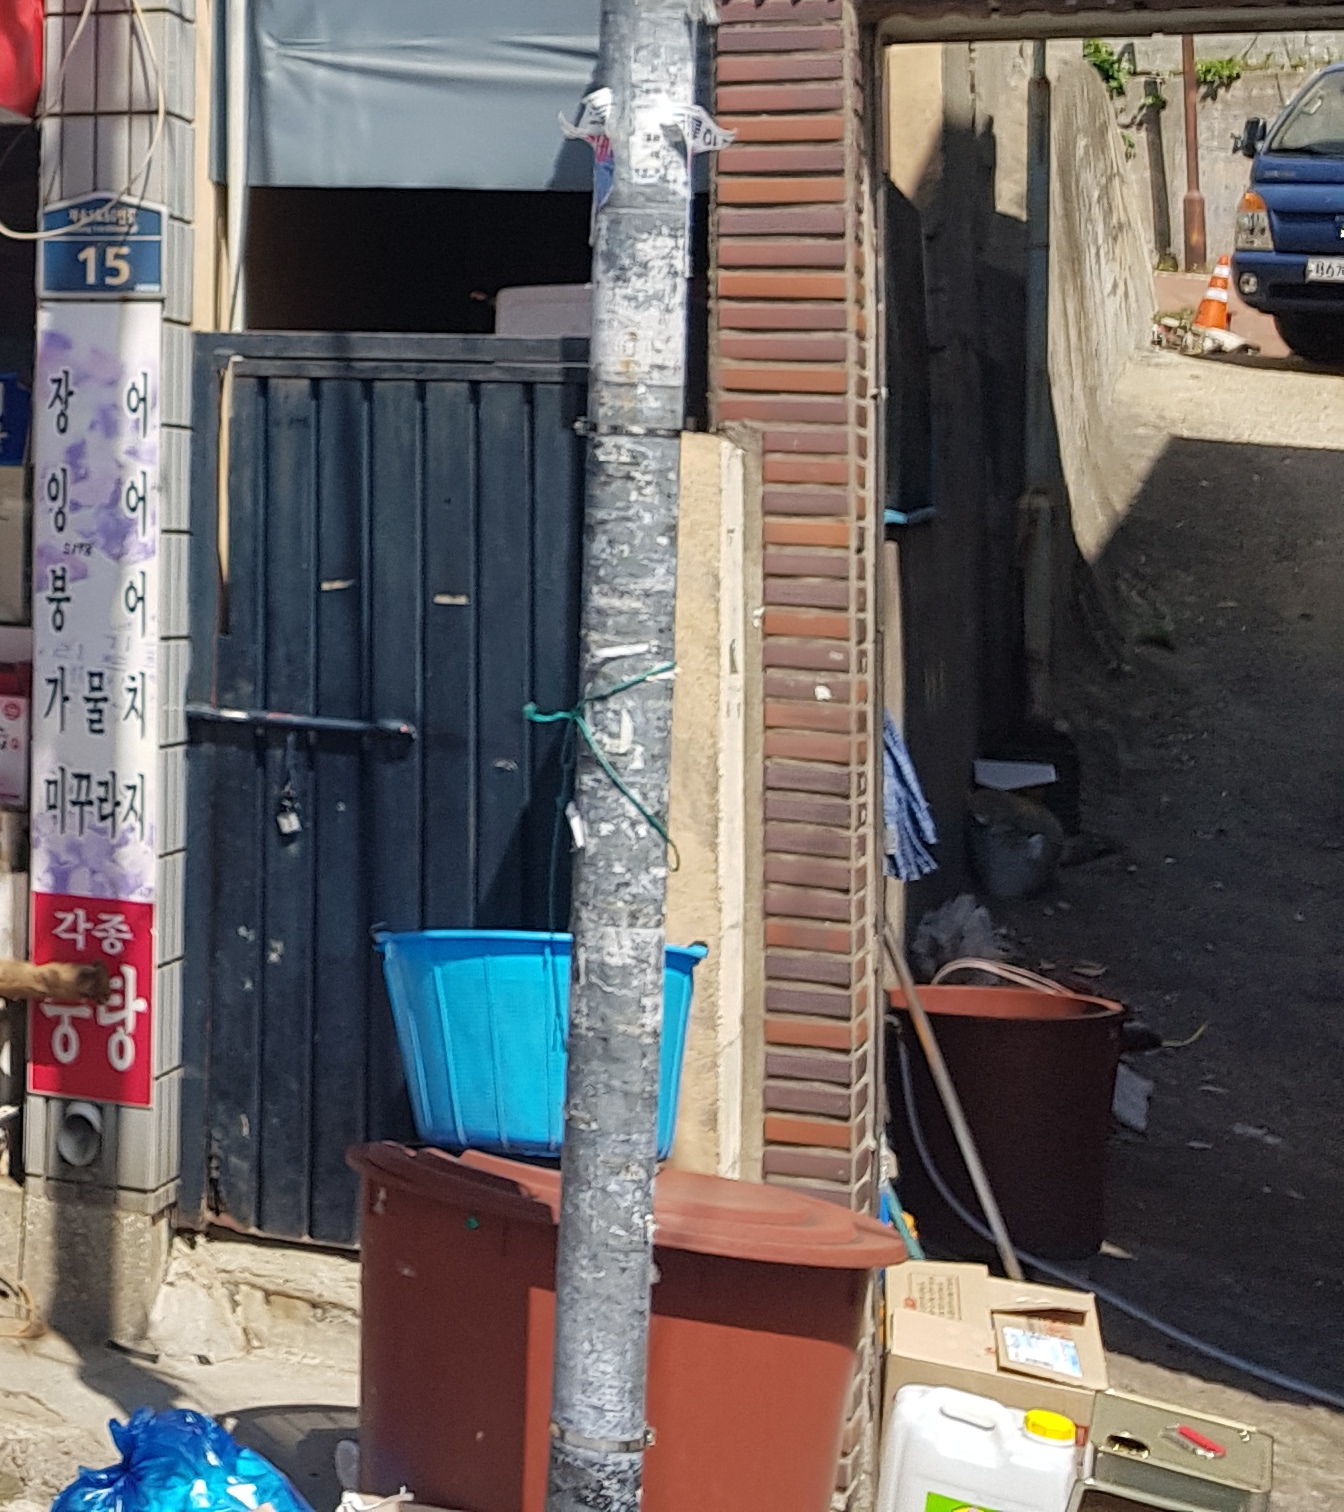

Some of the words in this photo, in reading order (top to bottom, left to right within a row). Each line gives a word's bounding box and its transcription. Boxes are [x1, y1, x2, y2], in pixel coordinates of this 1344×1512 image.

[76, 245, 131, 287] 15
[43, 766, 146, 841] 미꾸라지
[51, 908, 134, 956] 각종
